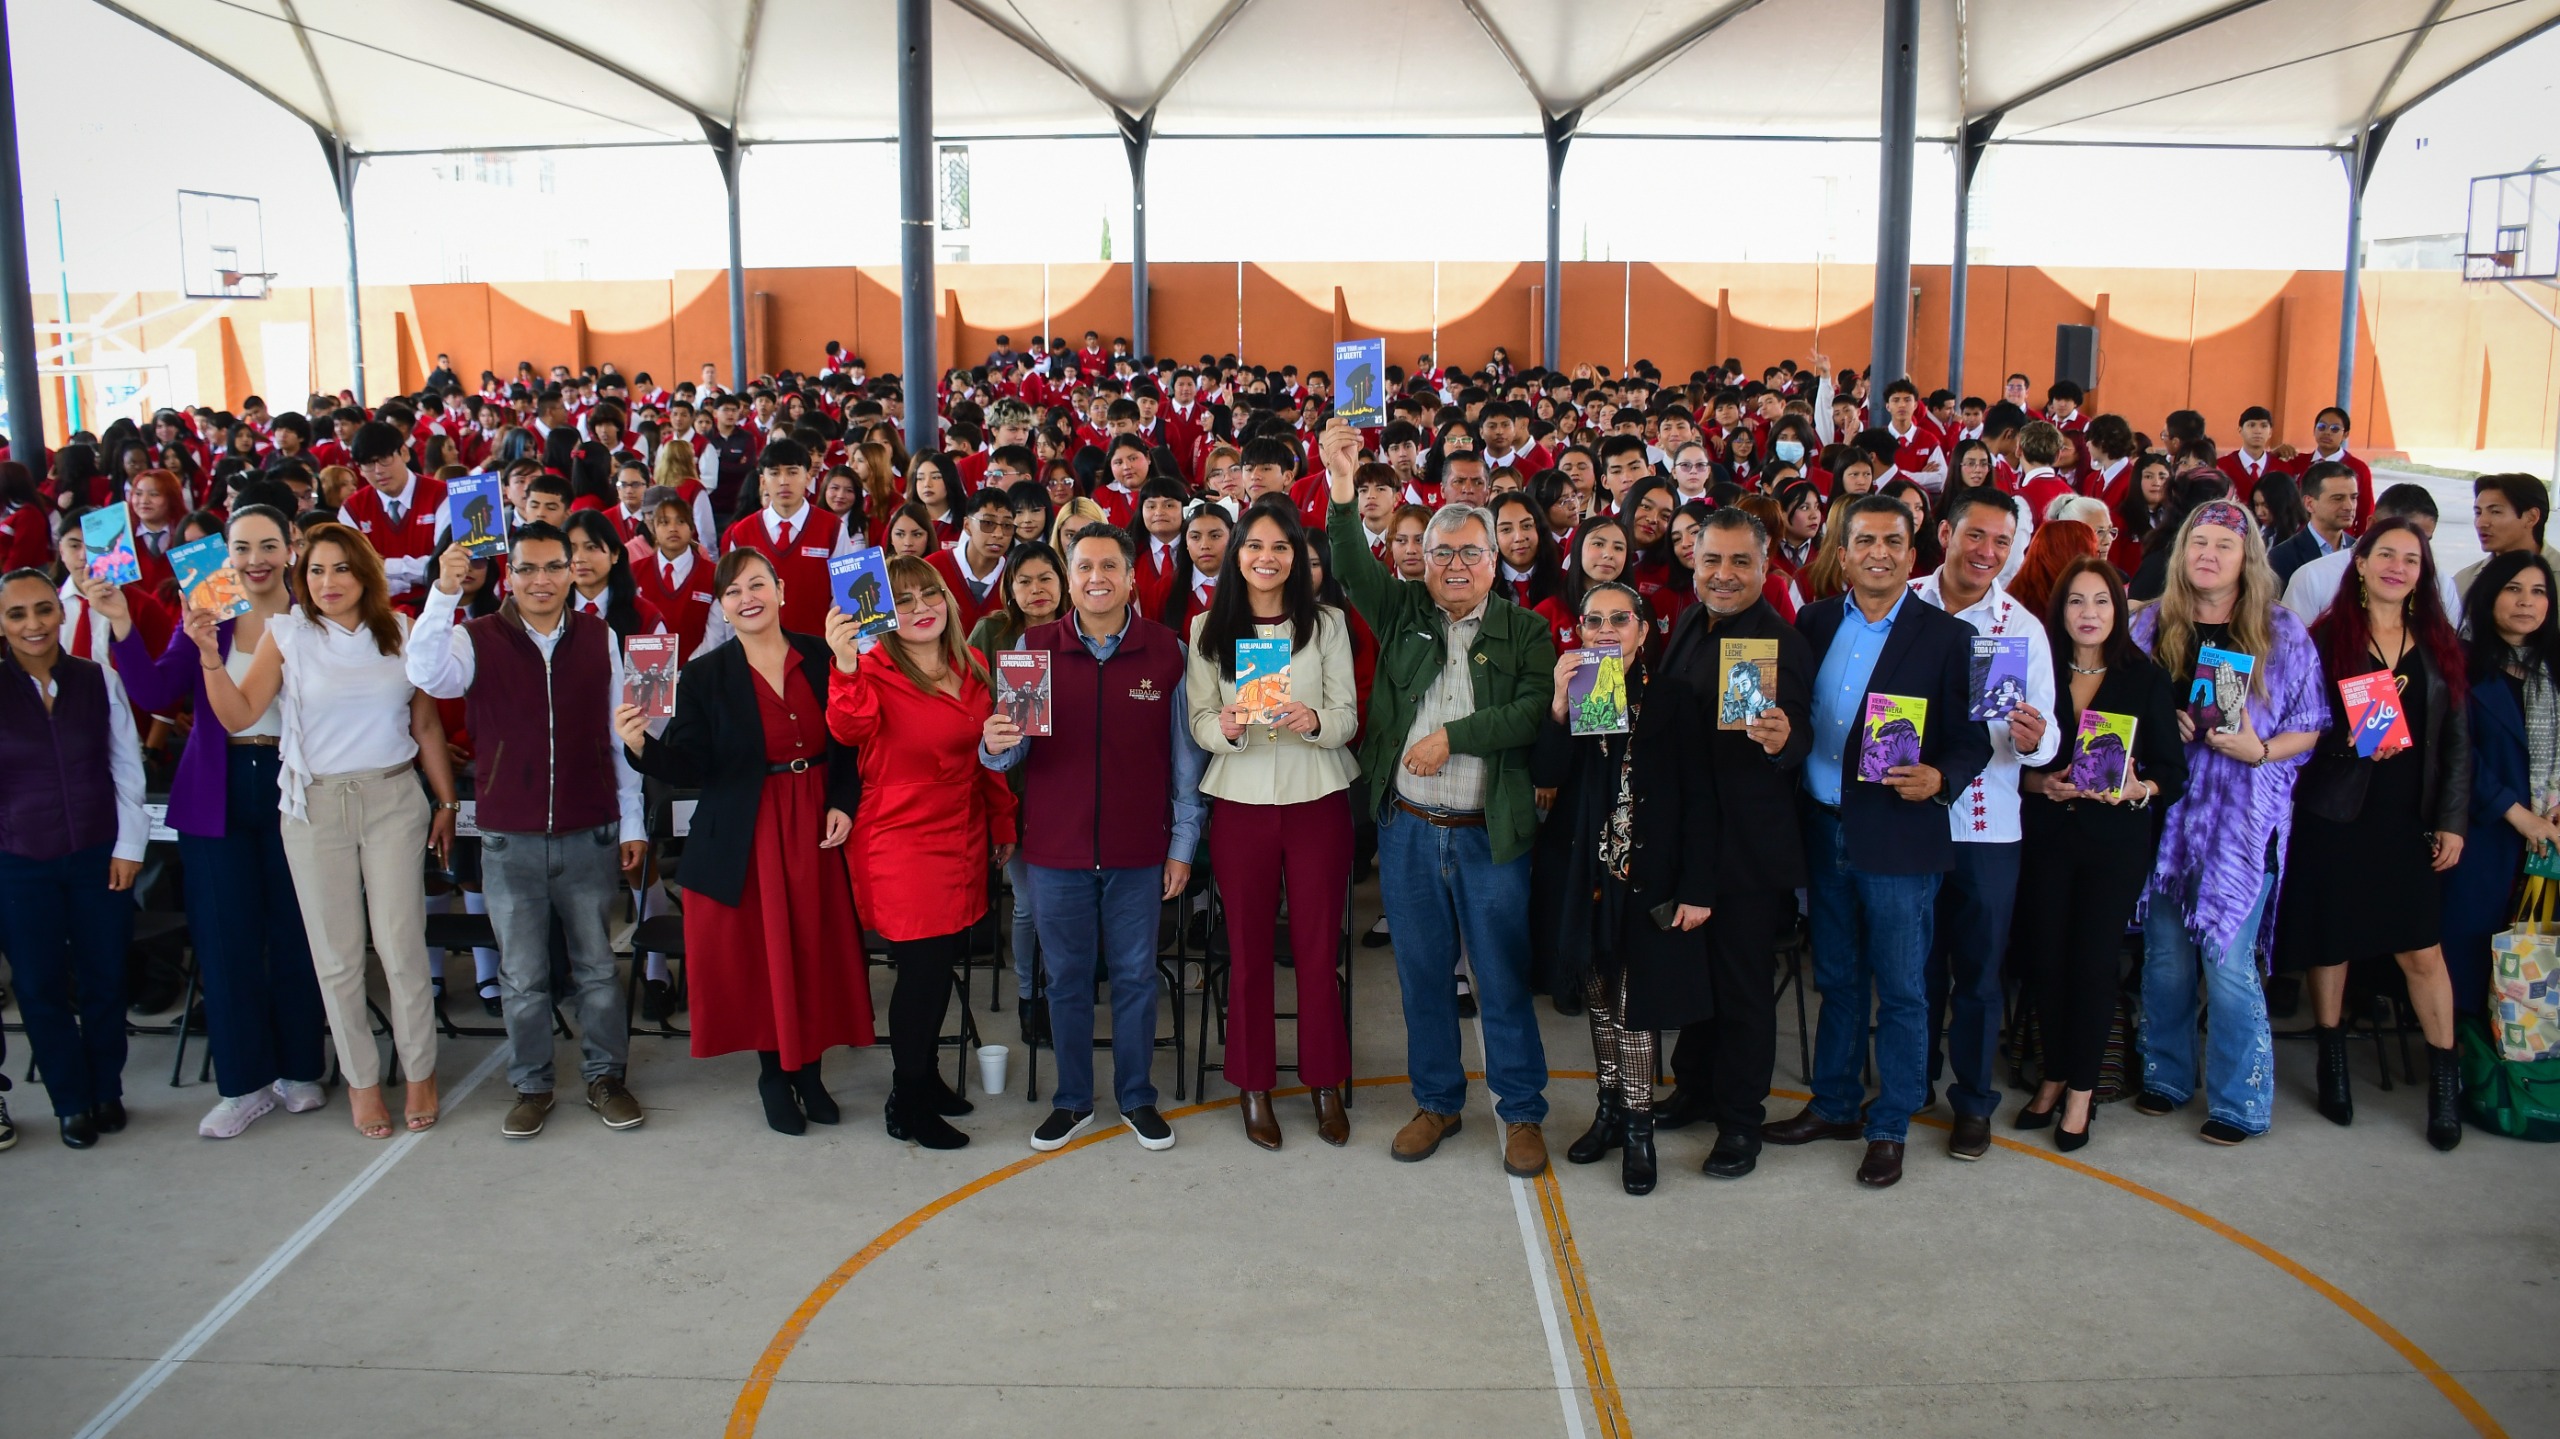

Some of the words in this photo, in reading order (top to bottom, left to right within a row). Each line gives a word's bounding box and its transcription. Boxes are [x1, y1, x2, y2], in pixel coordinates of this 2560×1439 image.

[1336, 352, 1343, 361] LA
[1343, 351, 1362, 360] MUERTE
[449, 487, 457, 496] LA
[831, 567, 840, 576] LA
[840, 562, 862, 574] MUERTE
[1239, 642, 1273, 650] HABLAPALABRA
[2201, 657, 2220, 665] TERESA
[1129, 688, 1161, 696] HIDALGO
[2345, 690, 2368, 701] ERNESTO
[1871, 697, 1888, 705] VIENTO
[2347, 696, 2370, 707] GUEVARA
[1870, 704, 1903, 714] PRIMAVERA
[2082, 719, 2112, 729] PRIMAVERA
